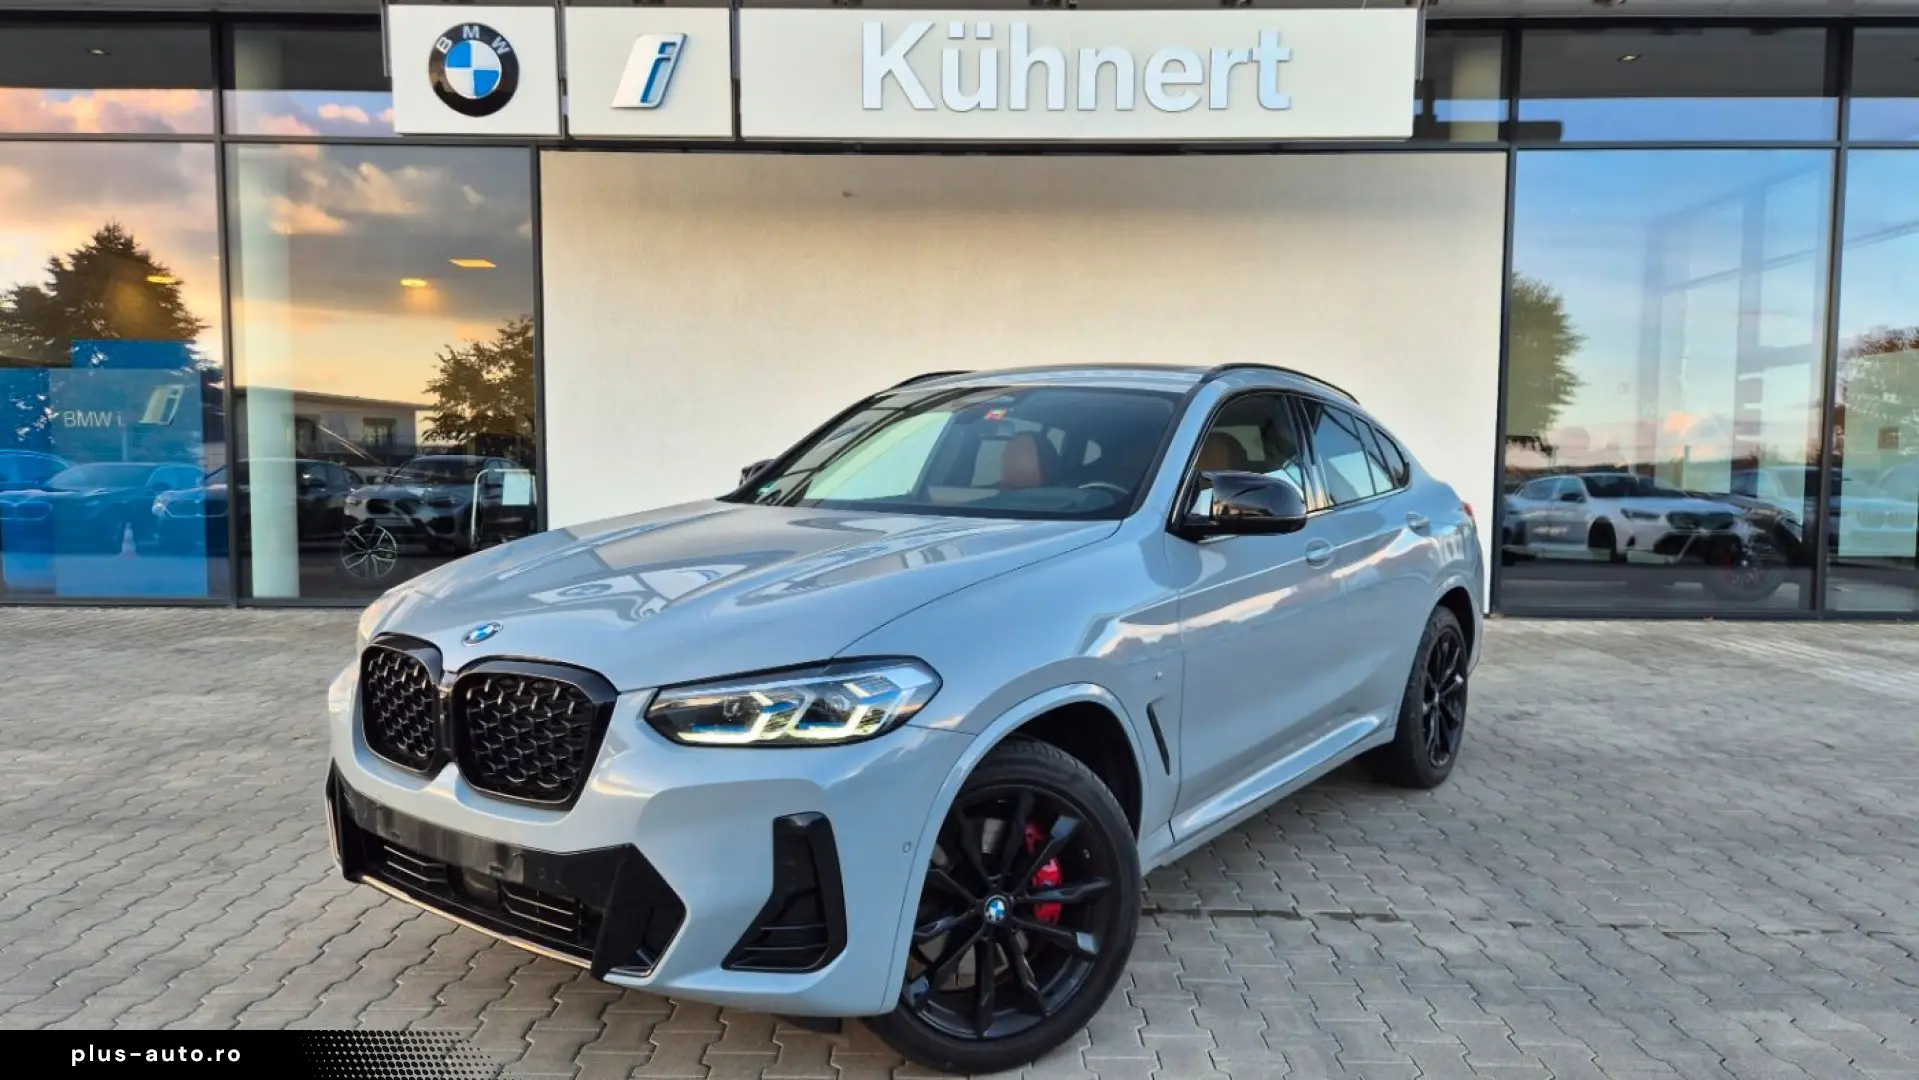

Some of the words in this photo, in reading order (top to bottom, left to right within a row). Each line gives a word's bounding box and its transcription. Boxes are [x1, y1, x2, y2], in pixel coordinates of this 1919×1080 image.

[435, 25, 511, 55] BMW
[861, 21, 1292, 112] Kühnert
[63, 410, 112, 428] BMW
